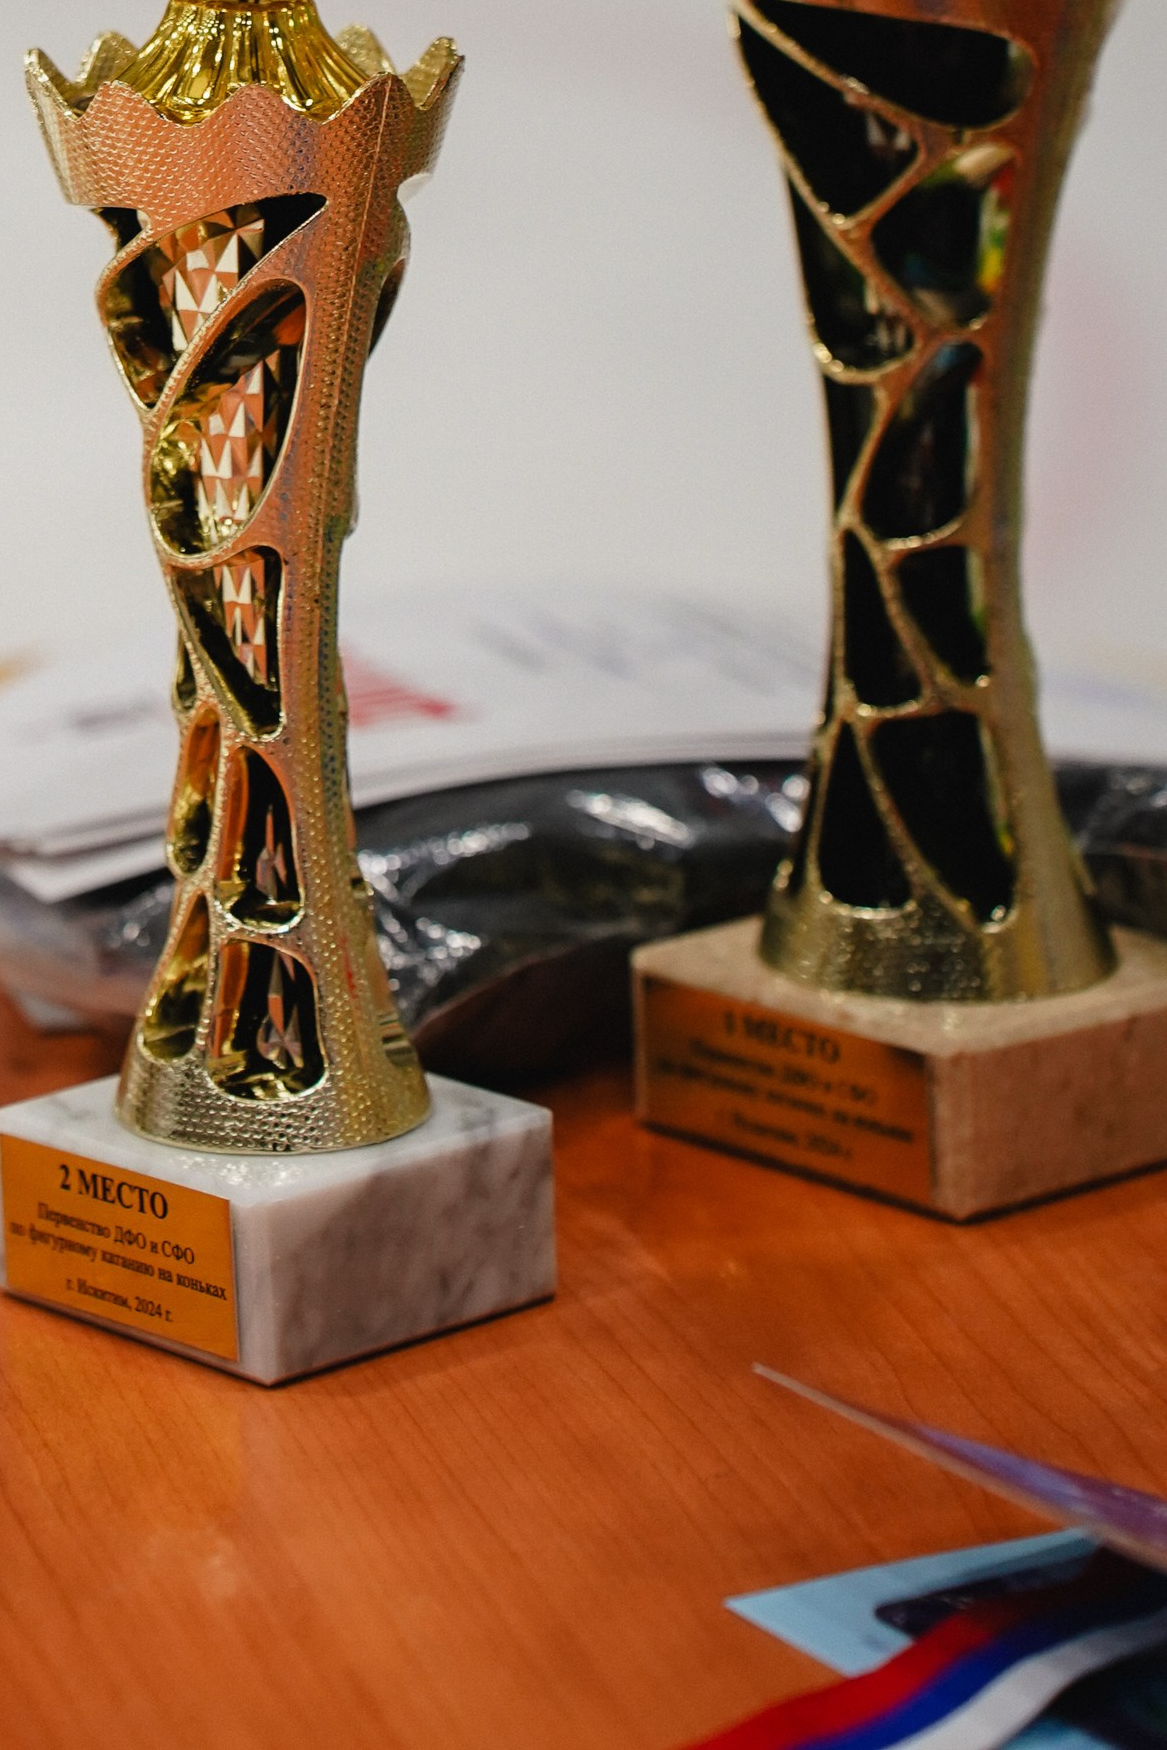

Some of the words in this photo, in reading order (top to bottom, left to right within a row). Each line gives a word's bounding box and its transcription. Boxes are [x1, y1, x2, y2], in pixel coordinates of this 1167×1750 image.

[59, 1164, 70, 1190] 2
[78, 1169, 168, 1219] МЕСТО
[37, 1203, 110, 1239] Первенство
[114, 1226, 146, 1250] ДФО
[150, 1239, 157, 1254] и
[162, 1241, 195, 1264] СФО
[28, 1225, 97, 1262] фигурному
[101, 1250, 155, 1277] катанию
[158, 1267, 173, 1282] на
[176, 1273, 227, 1301] коньках
[134, 1296, 162, 1318] 2024
